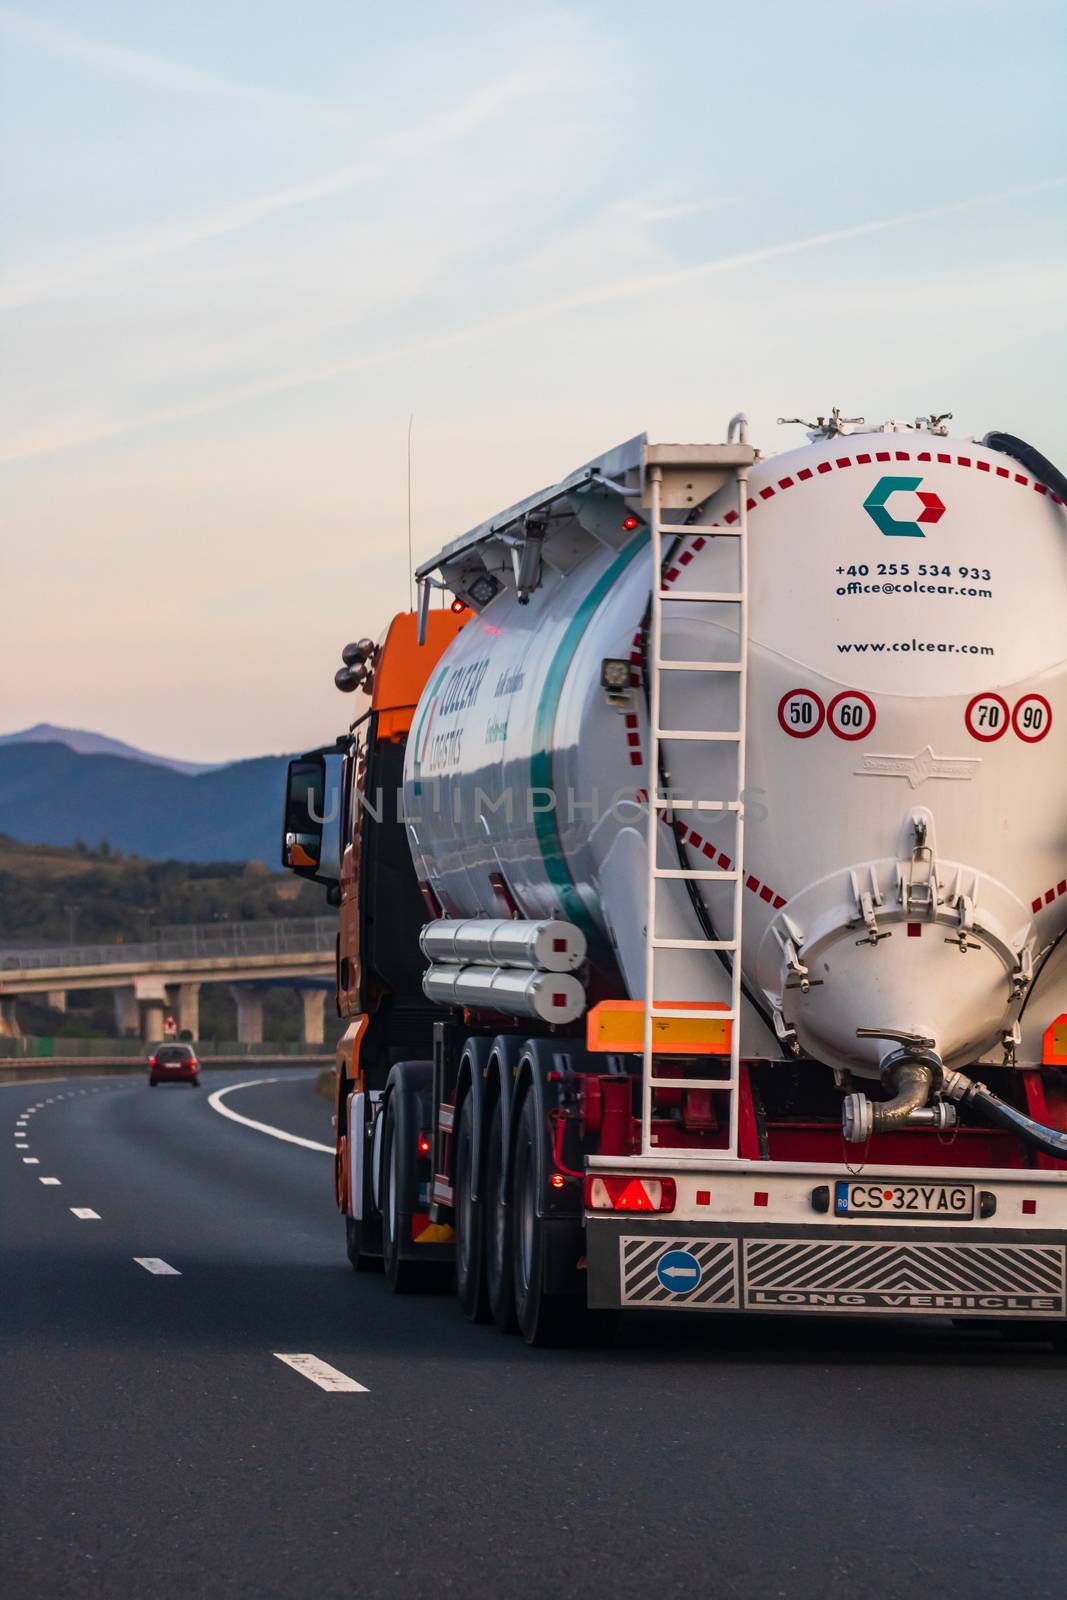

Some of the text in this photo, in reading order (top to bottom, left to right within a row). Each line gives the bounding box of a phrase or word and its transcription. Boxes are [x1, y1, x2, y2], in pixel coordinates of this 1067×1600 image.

[836, 564, 991, 581] +40 255 534 933
[836, 581, 992, 598] office@colcear.com
[837, 639, 994, 656] www.colcear.com
[439, 658, 490, 716] COLCEAR
[790, 702, 812, 724] 50
[840, 704, 863, 727] 60
[977, 705, 999, 728] 70
[1023, 707, 1043, 730] 90
[429, 728, 464, 771] LOGISTICS
[837, 1198, 848, 1208] RO
[851, 1186, 883, 1208] CS
[755, 1292, 1055, 1309] LONG VEHICLE
